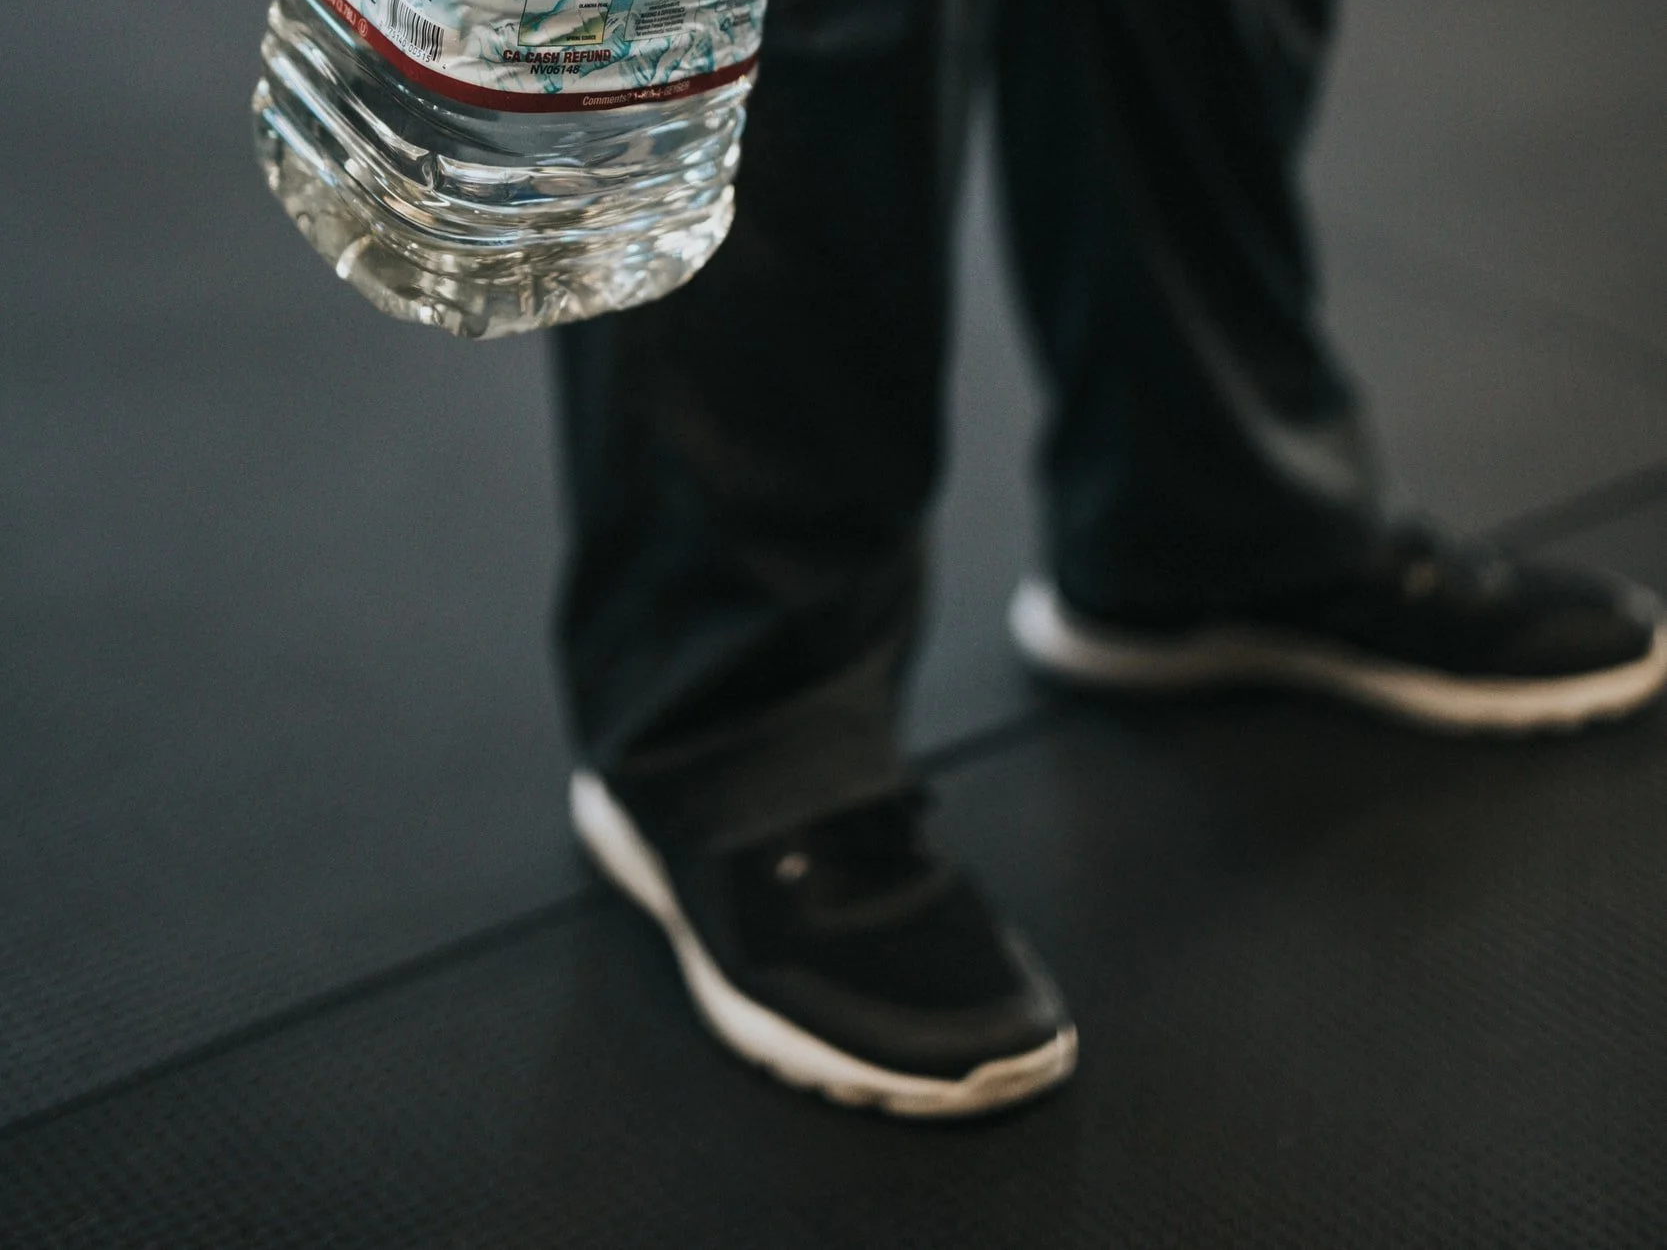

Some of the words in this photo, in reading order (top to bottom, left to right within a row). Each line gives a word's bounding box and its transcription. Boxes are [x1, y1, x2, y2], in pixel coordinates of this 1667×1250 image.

[503, 50, 522, 63] CA
[525, 52, 560, 64] CASH
[563, 49, 611, 64] REFUND
[530, 64, 580, 75] NV06148
